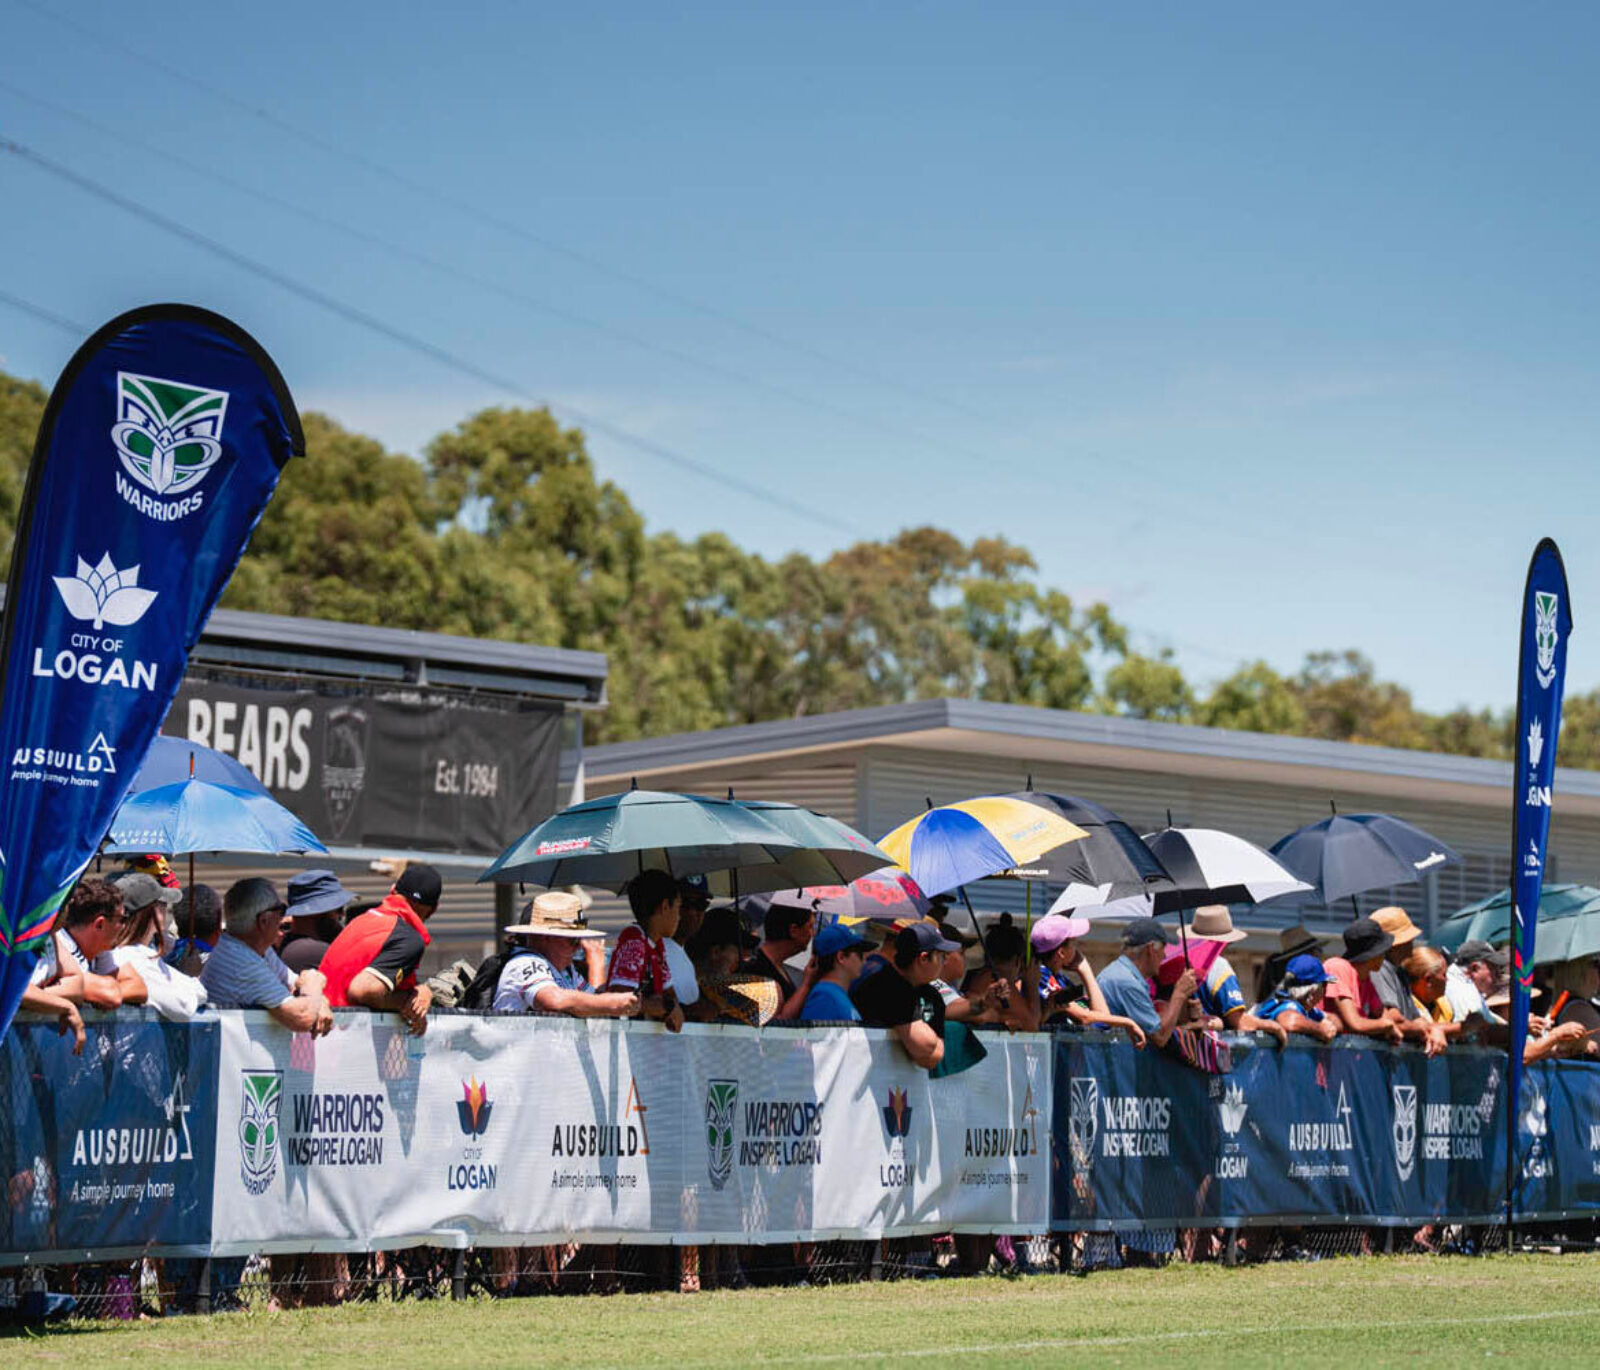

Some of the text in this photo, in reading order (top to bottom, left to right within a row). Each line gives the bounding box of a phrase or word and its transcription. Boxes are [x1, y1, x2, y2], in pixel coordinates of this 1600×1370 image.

[116, 471, 203, 521] WARRIORS
[71, 633, 124, 652] CITY OF
[33, 647, 158, 691] LOGAN
[70, 774, 100, 787] home
[464, 763, 498, 797] 1984
[293, 1093, 384, 1133] WARRIORS
[744, 1101, 824, 1137] WARRIORS
[1103, 1096, 1172, 1130] WARRIORS
[1422, 1103, 1481, 1135] WARRIORS
[72, 1127, 179, 1166] AUSBUILD
[551, 1124, 638, 1157] AUSBUILD
[965, 1127, 1029, 1157] AUSBUILD
[1102, 1132, 1170, 1157] INSPIRE LOGAN
[1289, 1122, 1346, 1151] AUSBUILD
[1452, 1136, 1483, 1159] LOGAN
[288, 1137, 383, 1166] INSPIRE LOGAN
[739, 1140, 821, 1166] INSPIRE LOGAN
[448, 1164, 497, 1190] LOGAN
[551, 1169, 560, 1188] A
[880, 1164, 916, 1187] LOGAN
[1215, 1156, 1248, 1178] LOGAN
[70, 1176, 175, 1204] A simple journey home
